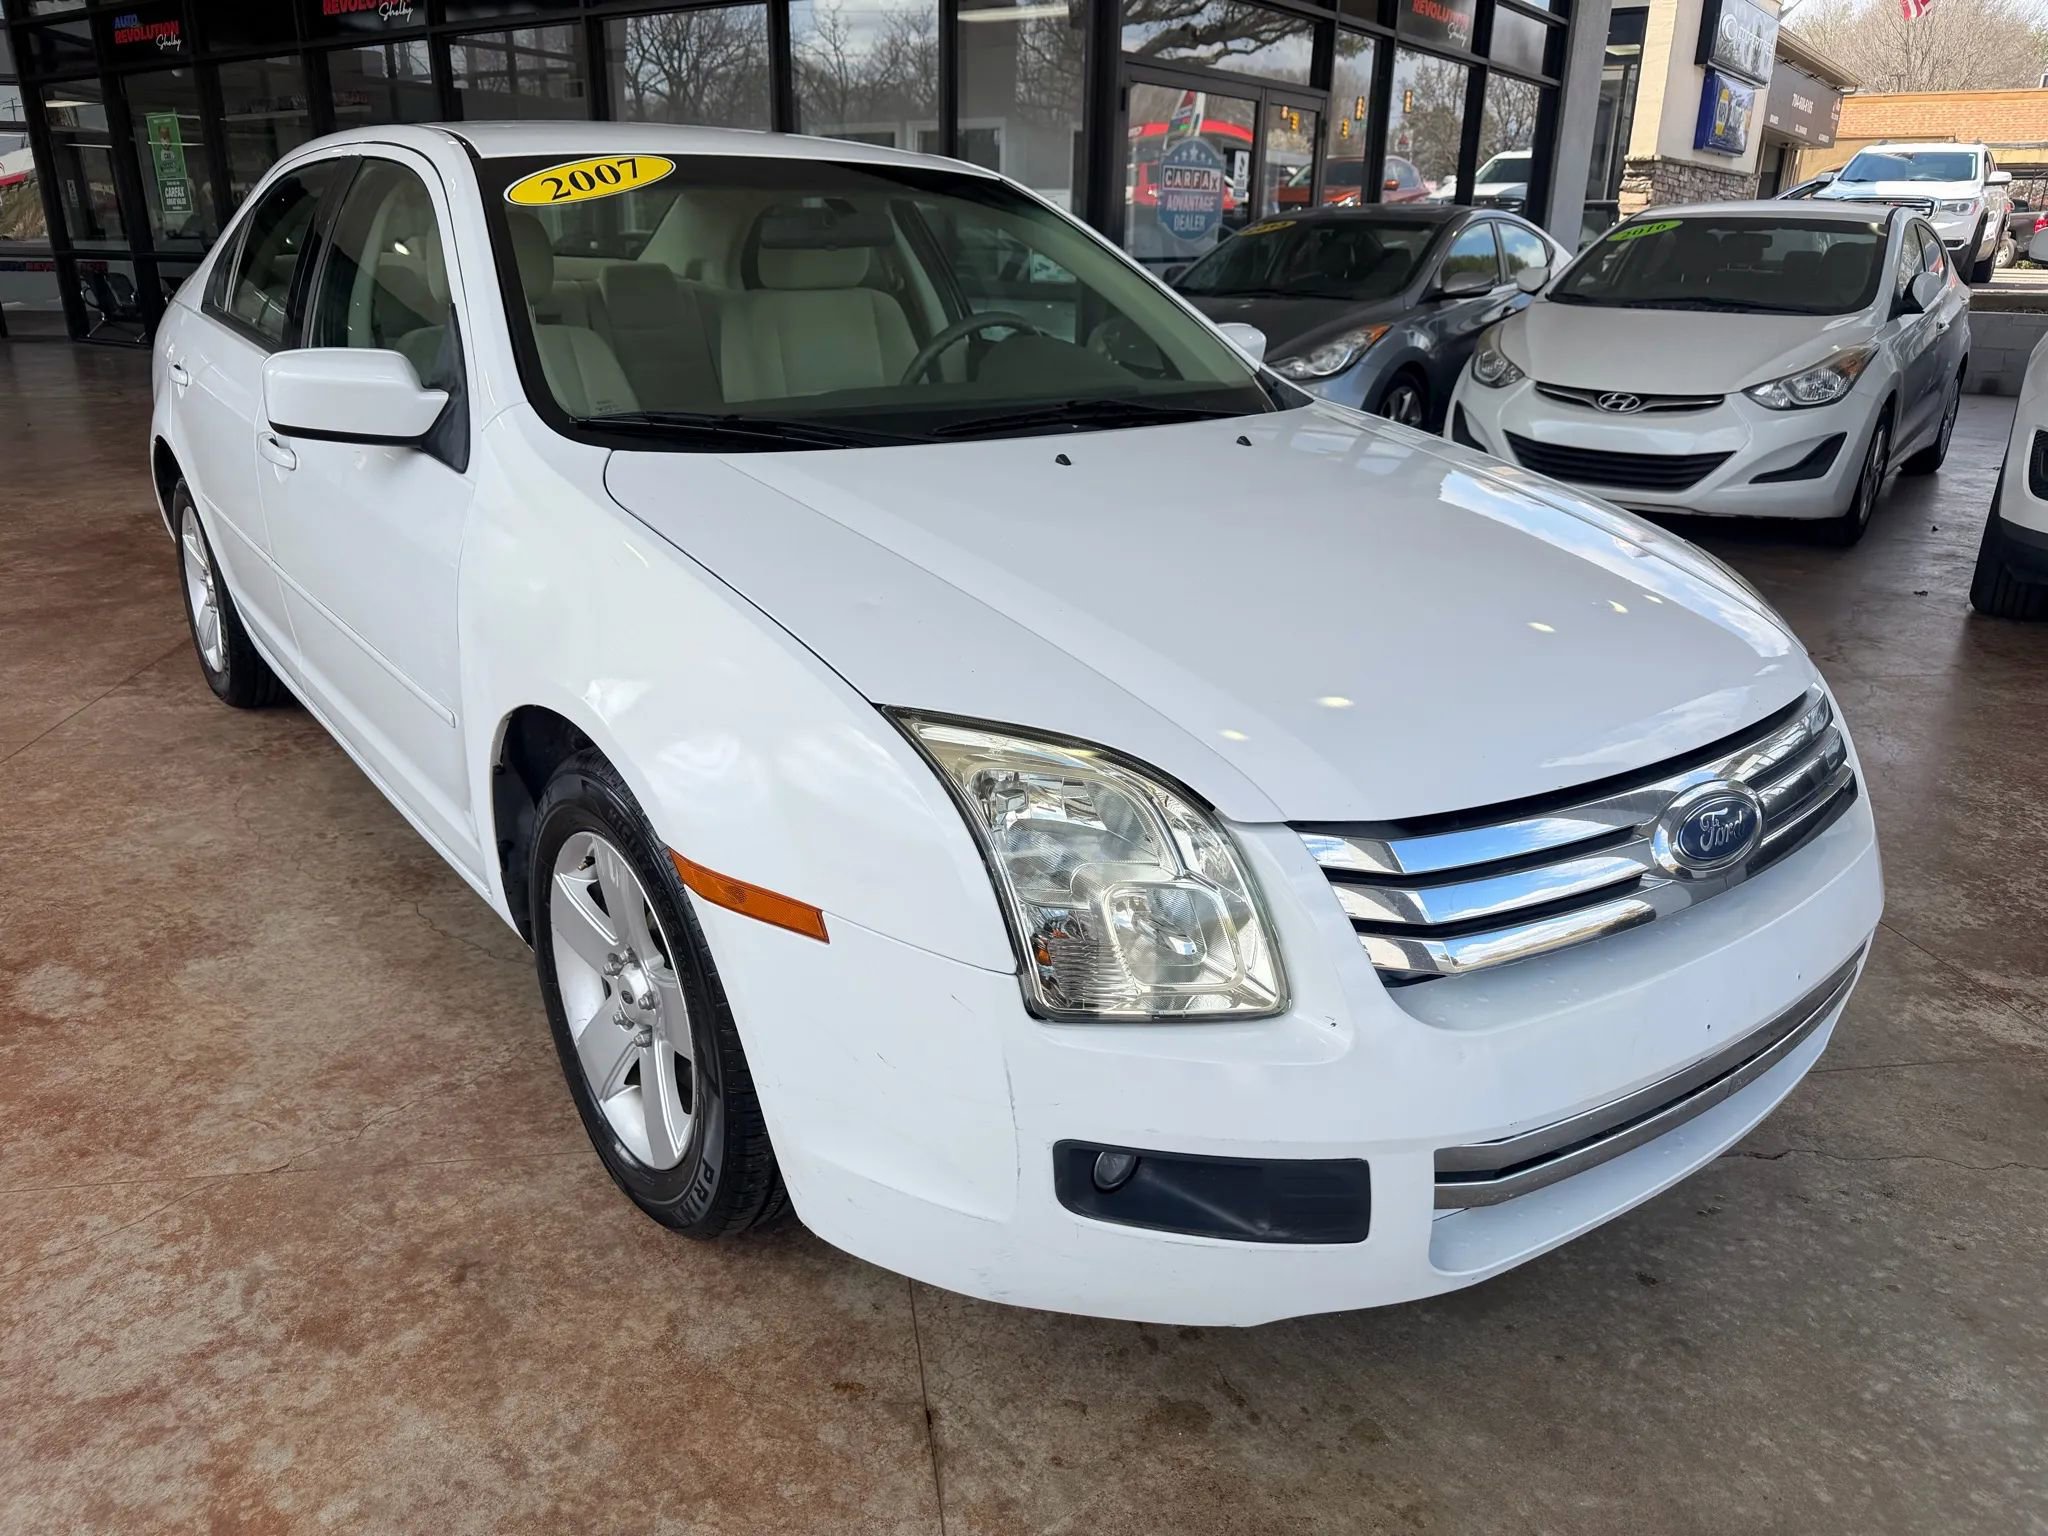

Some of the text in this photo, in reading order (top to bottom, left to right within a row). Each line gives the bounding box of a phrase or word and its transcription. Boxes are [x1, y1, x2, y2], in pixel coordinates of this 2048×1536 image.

[114, 14, 138, 29] AUTO
[379, 2, 413, 22] Shelby
[115, 21, 179, 44] REVOLUTION
[156, 32, 181, 51] Shelby
[541, 158, 637, 201] 2007
[1165, 167, 1219, 190] CARFAX
[1166, 194, 1214, 212] ADVANTAGE
[1173, 213, 1206, 231] DEALER
[1700, 807, 1744, 851] Ford
